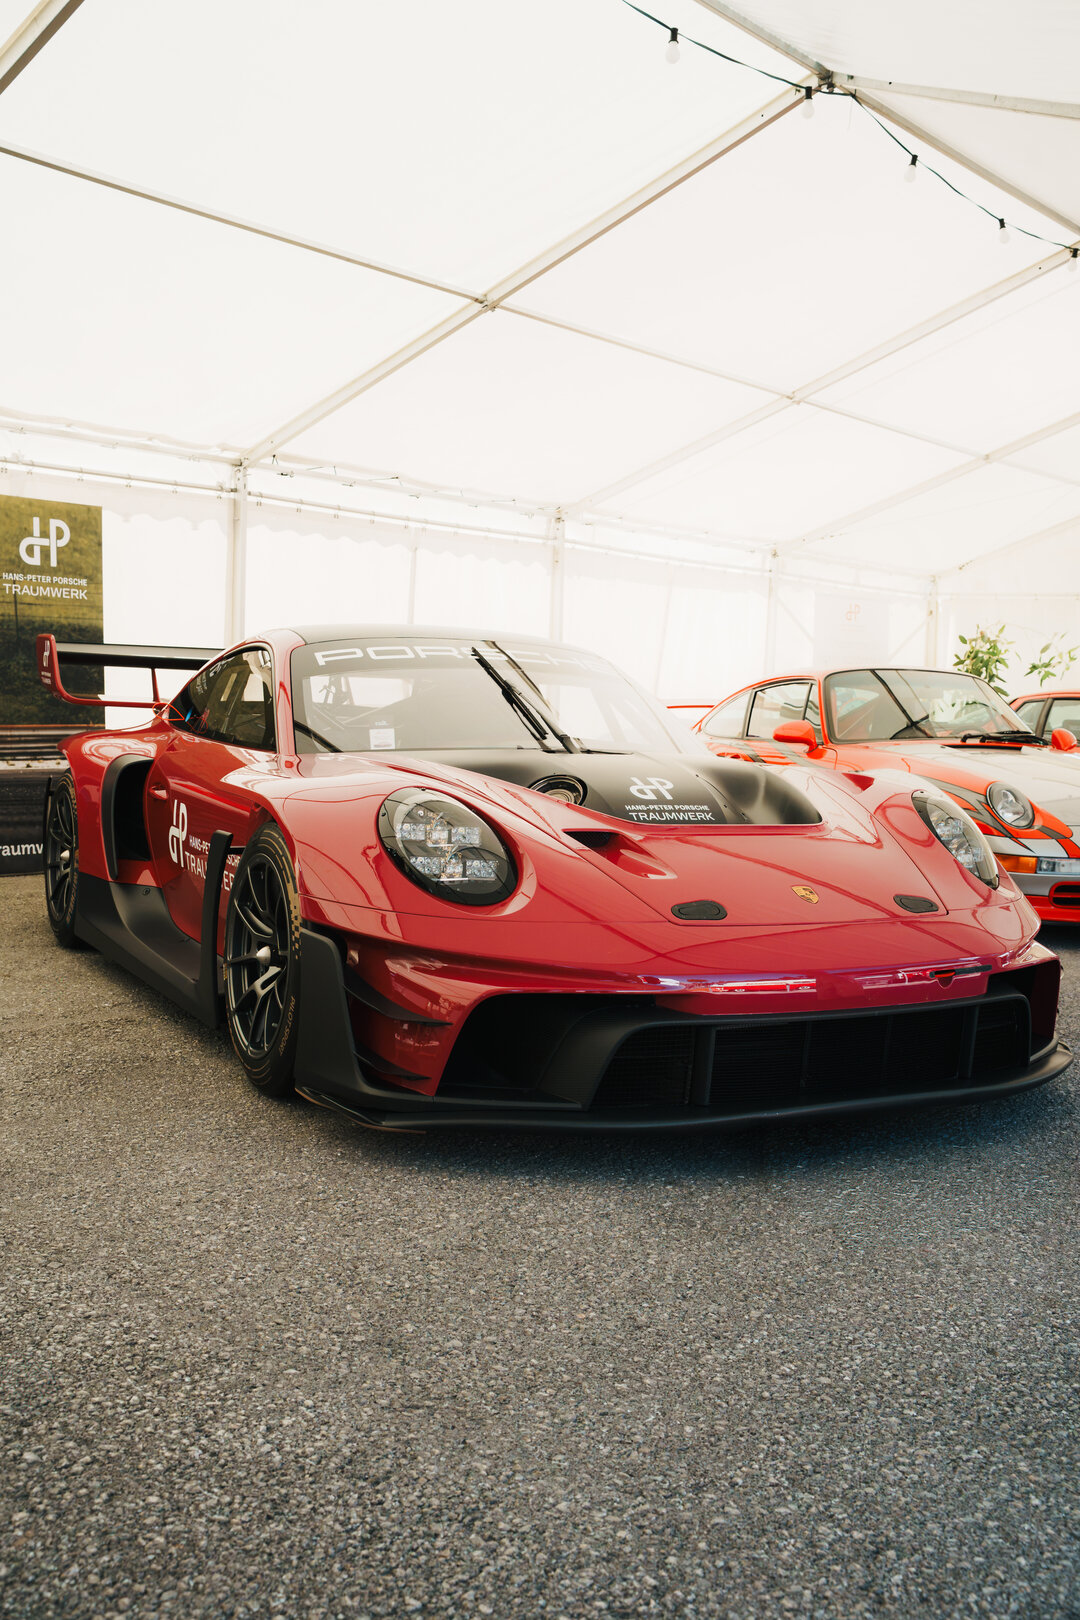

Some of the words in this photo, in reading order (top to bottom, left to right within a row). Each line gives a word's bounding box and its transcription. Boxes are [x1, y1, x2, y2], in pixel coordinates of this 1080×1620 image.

[2, 572, 51, 584] HANS-PETER
[52, 576, 88, 586] PORSCHE
[2, 583, 88, 600] TRAUMWERK
[628, 812, 716, 821] TRAUMWERK
